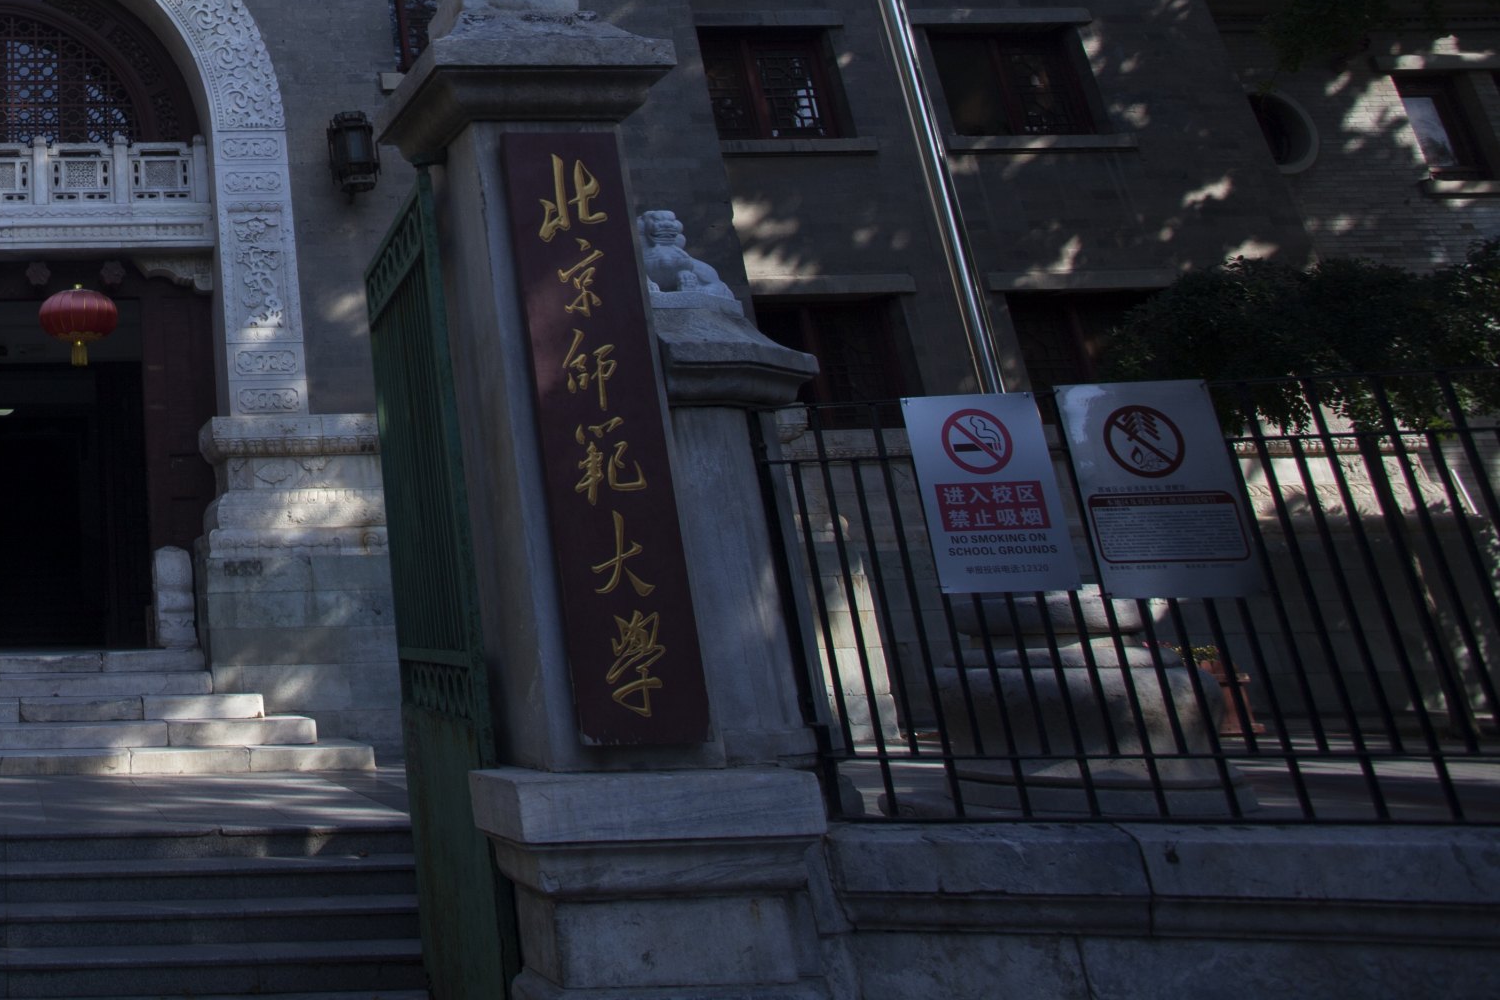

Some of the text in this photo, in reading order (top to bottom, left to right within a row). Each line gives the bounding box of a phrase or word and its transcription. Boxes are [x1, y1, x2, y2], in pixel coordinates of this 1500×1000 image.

[943, 484, 1038, 505] 进入校区
[948, 507, 1044, 528] 禁止吸烟
[950, 532, 1047, 544] NO SMOKING ON
[948, 545, 1058, 556] SCHOOL GROUNDS
